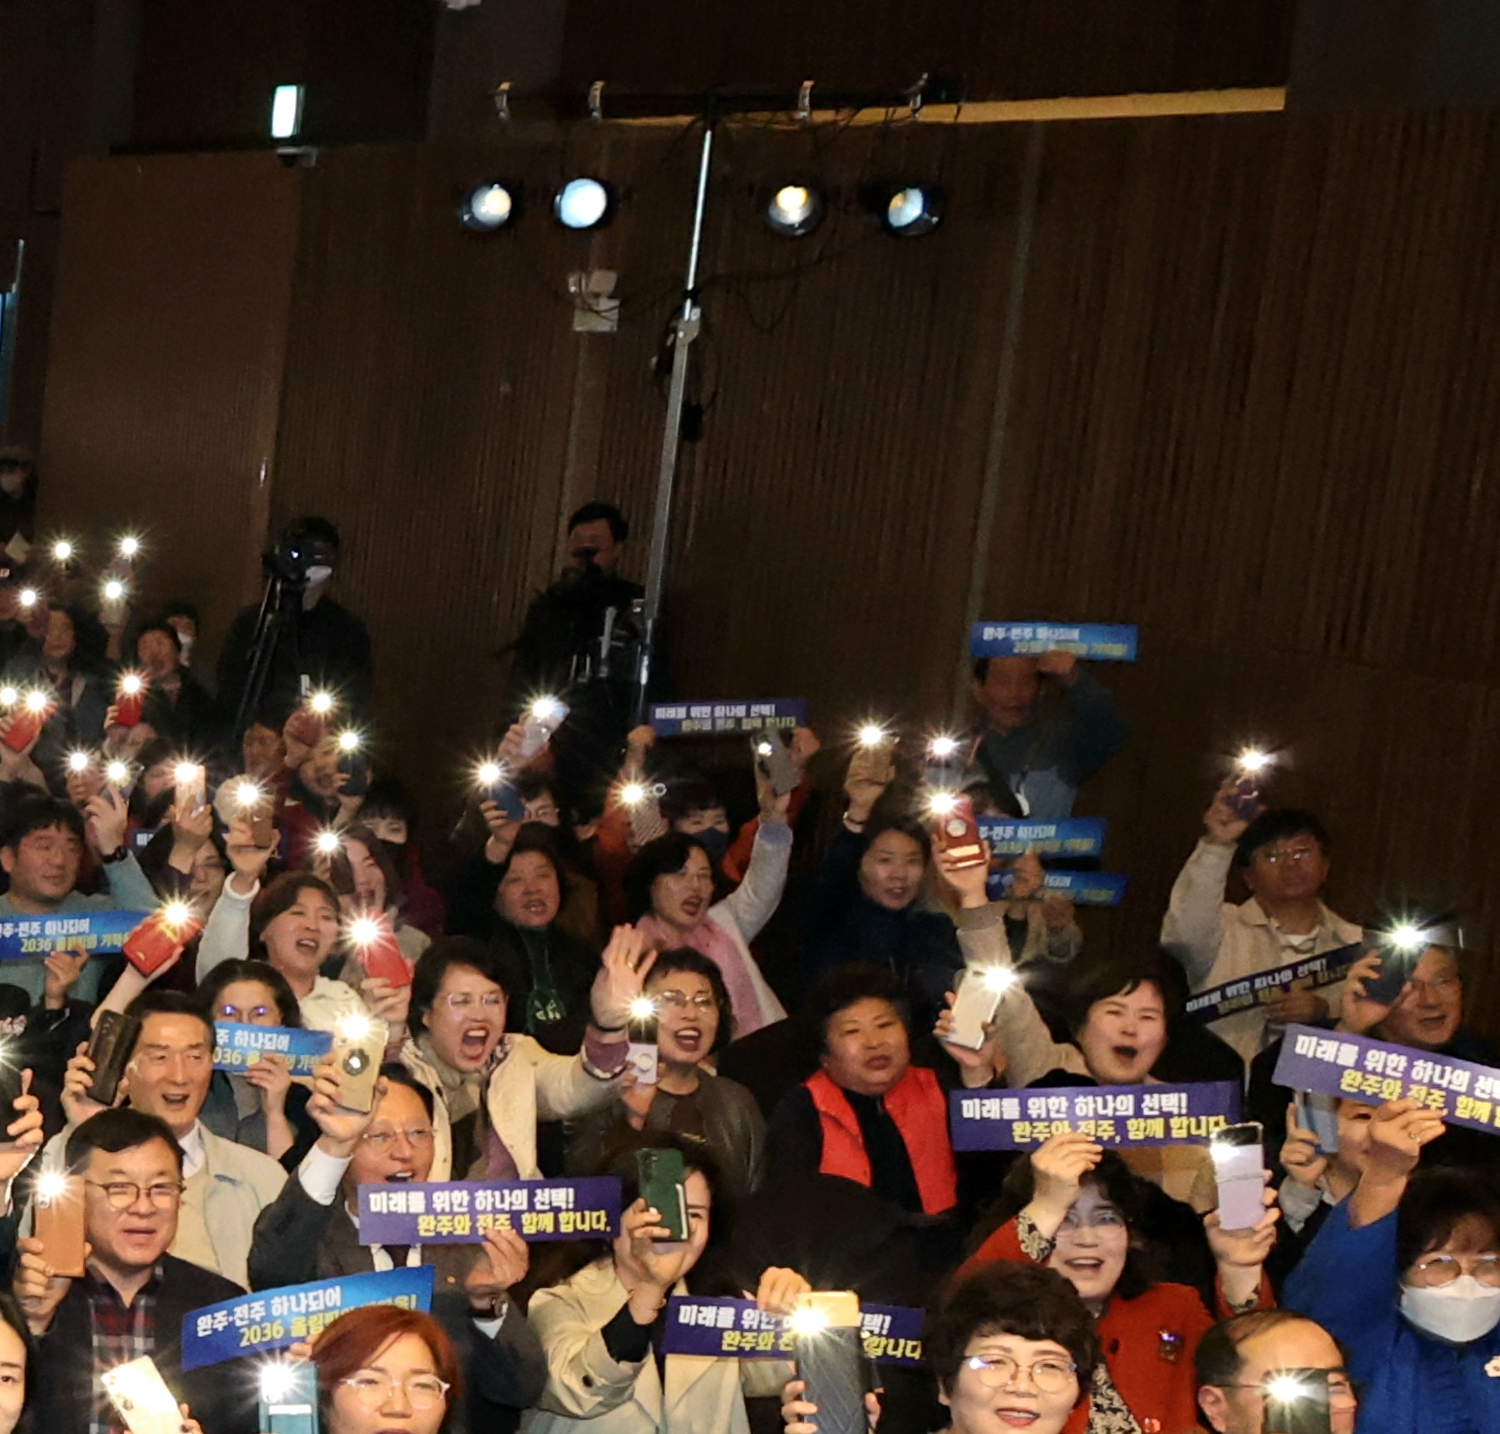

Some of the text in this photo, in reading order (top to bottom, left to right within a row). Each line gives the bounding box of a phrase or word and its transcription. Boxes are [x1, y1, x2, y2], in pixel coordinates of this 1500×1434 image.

[21, 937, 51, 953] 2036
[234, 1031, 289, 1050] 하나되어
[1294, 1034, 1471, 1093] 미래를 위한 하나의
[961, 1093, 1187, 1121] 미래를 위한 하나의 선택!
[1339, 1069, 1490, 1125] 완주와 함께
[1128, 1117, 1164, 1140] 함께
[369, 1188, 573, 1213] 미래를 위한 하나의 선택!
[418, 1211, 610, 1237] 완주와 함께 합니다.
[196, 1286, 341, 1339] 완주·전주 하나되어
[678, 1304, 736, 1329] 미래를
[240, 1323, 283, 1347] 2036
[722, 1331, 776, 1351] 완주와
